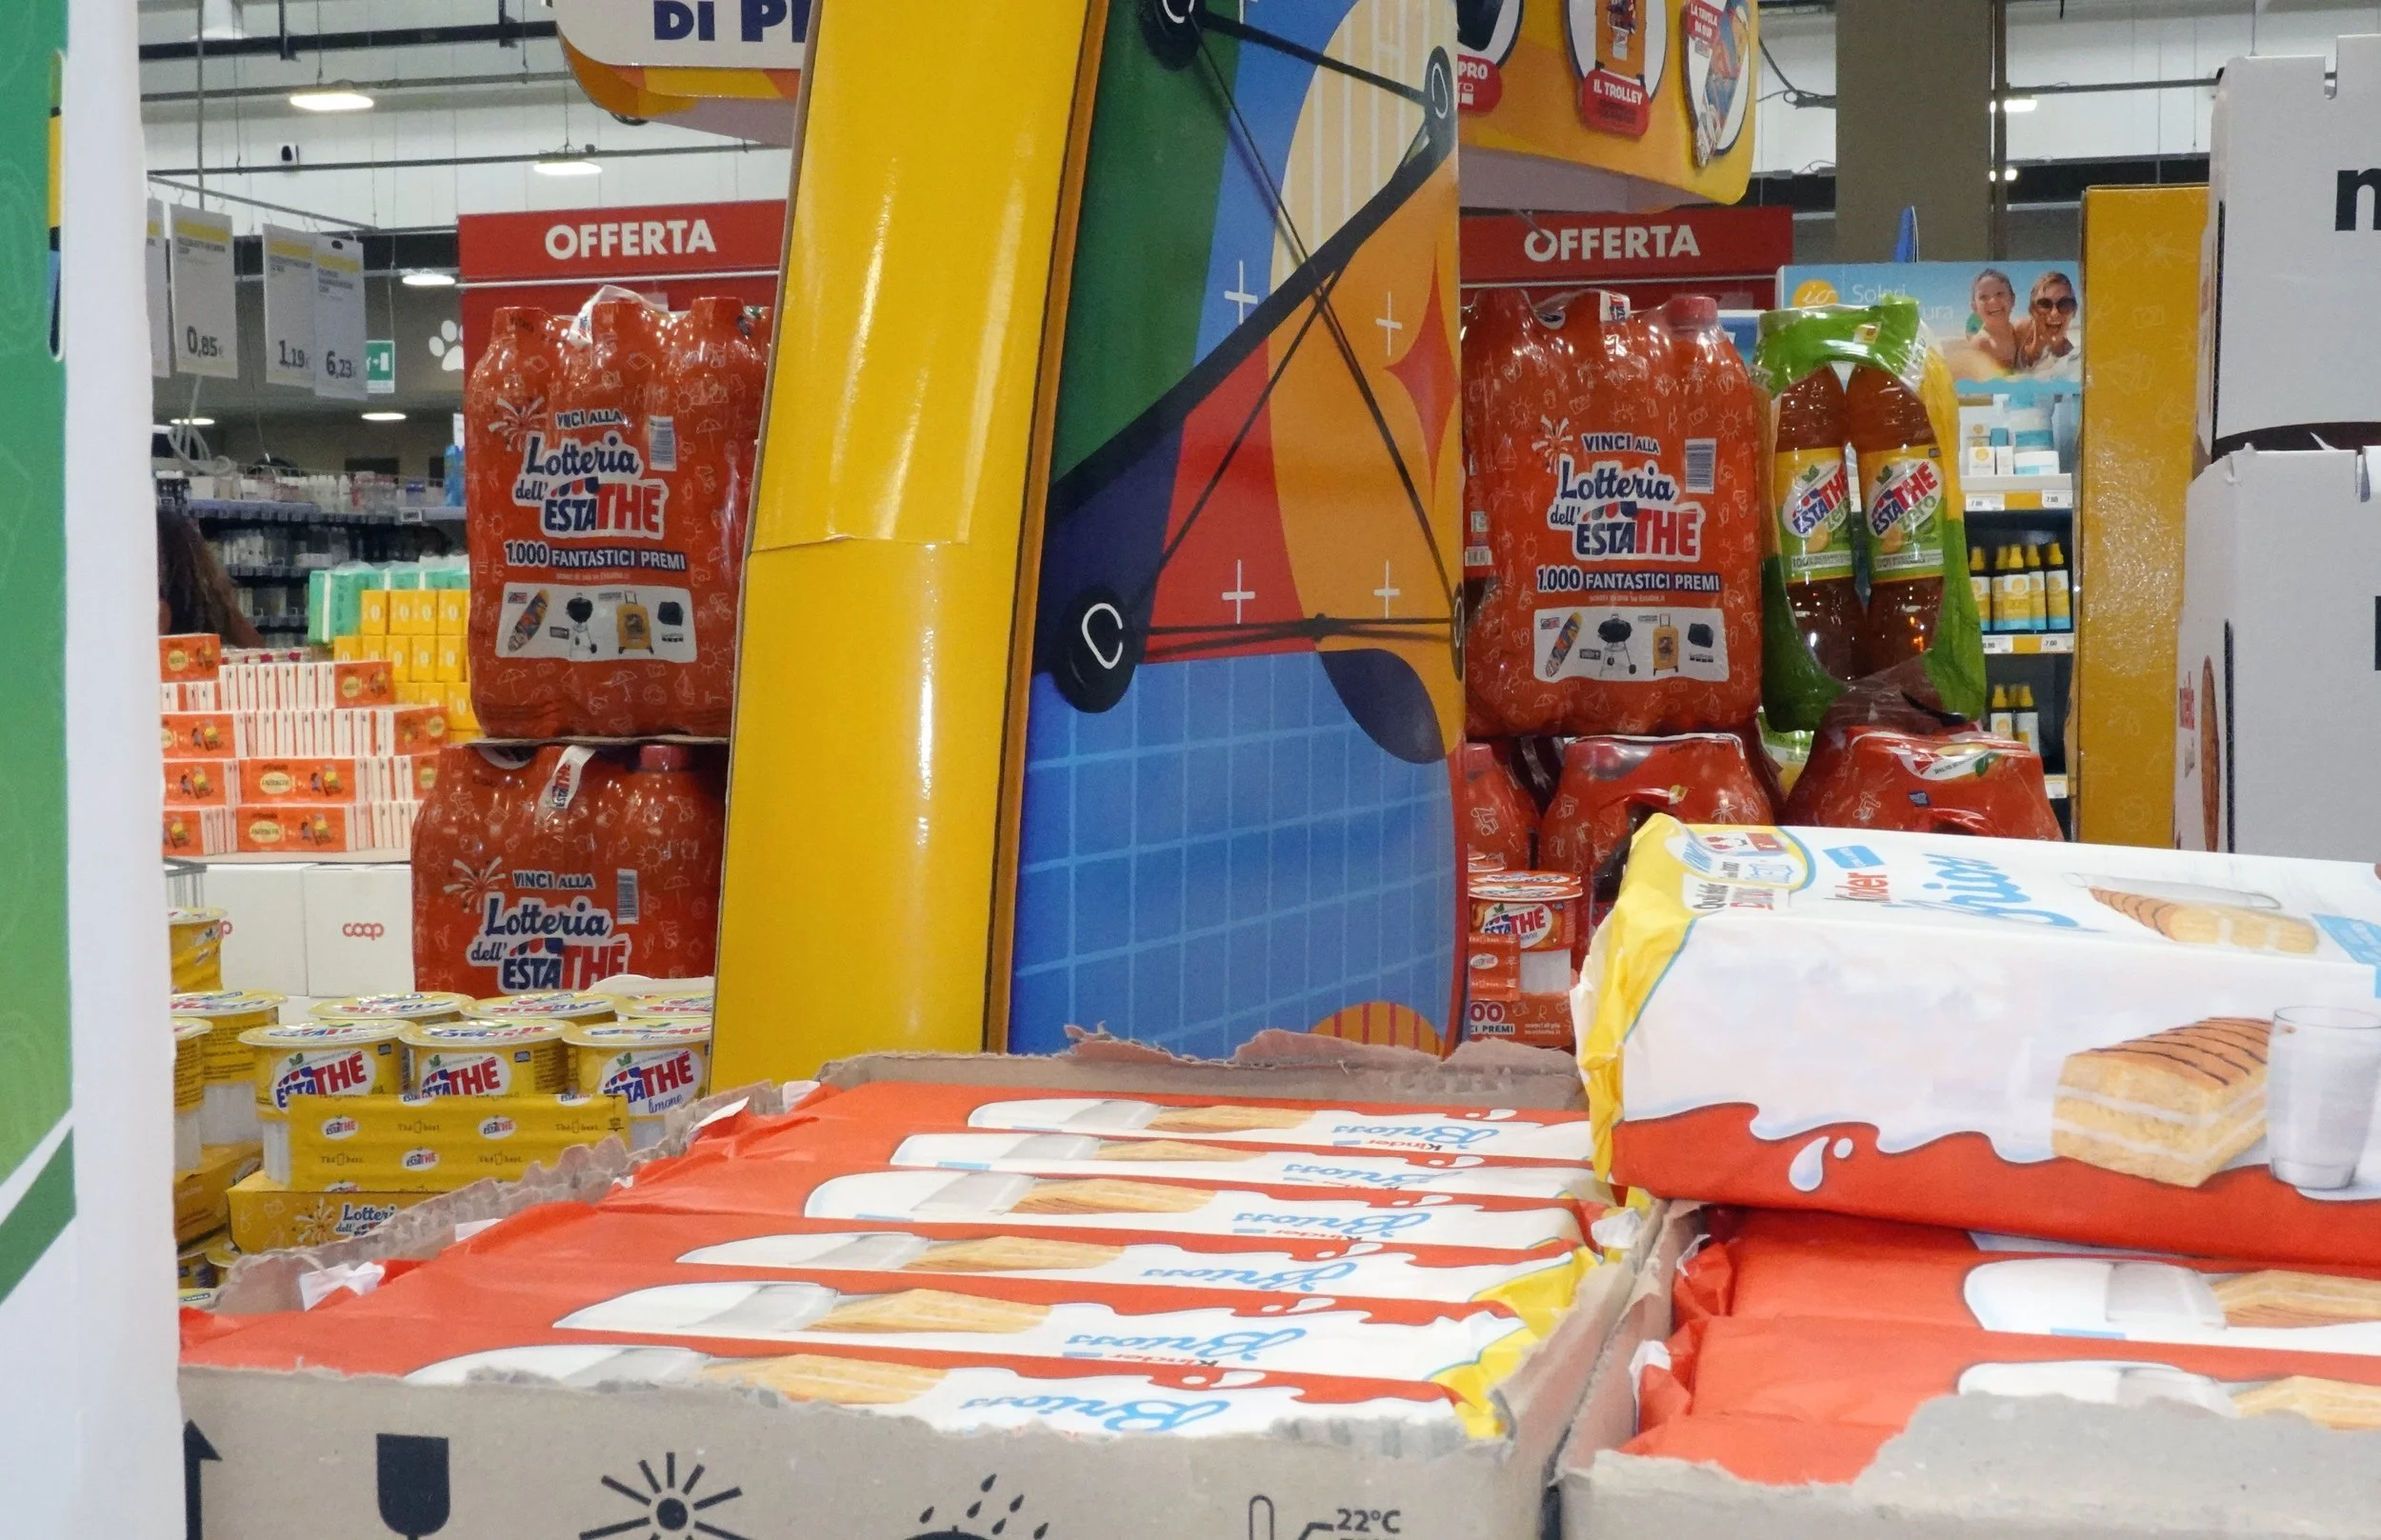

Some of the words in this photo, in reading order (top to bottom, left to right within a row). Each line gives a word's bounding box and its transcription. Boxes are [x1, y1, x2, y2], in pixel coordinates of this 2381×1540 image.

[654, 0, 714, 41] DI
[1593, 79, 1607, 93] IL
[1604, 85, 1643, 106] TROLLEY
[545, 219, 716, 260] OFFERTA
[1525, 226, 1701, 262] OFFERTA
[525, 435, 639, 476] Lotteria
[1583, 434, 1631, 450] VINCI
[1633, 440, 1659, 453] ALLA
[515, 479, 550, 501] dell'
[1560, 460, 1675, 501] Lotteria
[1550, 507, 1581, 525] dell'
[551, 549, 635, 567] FANTASTICI
[640, 552, 686, 570] PREMI
[1586, 574, 1671, 590] FANTASTICI
[1674, 574, 1720, 590] PREMI
[512, 872, 552, 889] VINCI
[558, 874, 594, 889] ALLA
[485, 897, 610, 936] Lotteria
[343, 922, 384, 940] coop
[470, 941, 507, 962] dell'
[1482, 1023, 1513, 1033] PREMI
[648, 1093, 683, 1114] limone
[1331, 1126, 1500, 1149] Brioss
[1233, 1212, 1432, 1237] Brioss
[1141, 1262, 1357, 1291] Brioss
[1064, 1328, 1308, 1361] Brioss
[959, 1395, 1231, 1431] Brioss
[1336, 1508, 1401, 1533] 22°C
